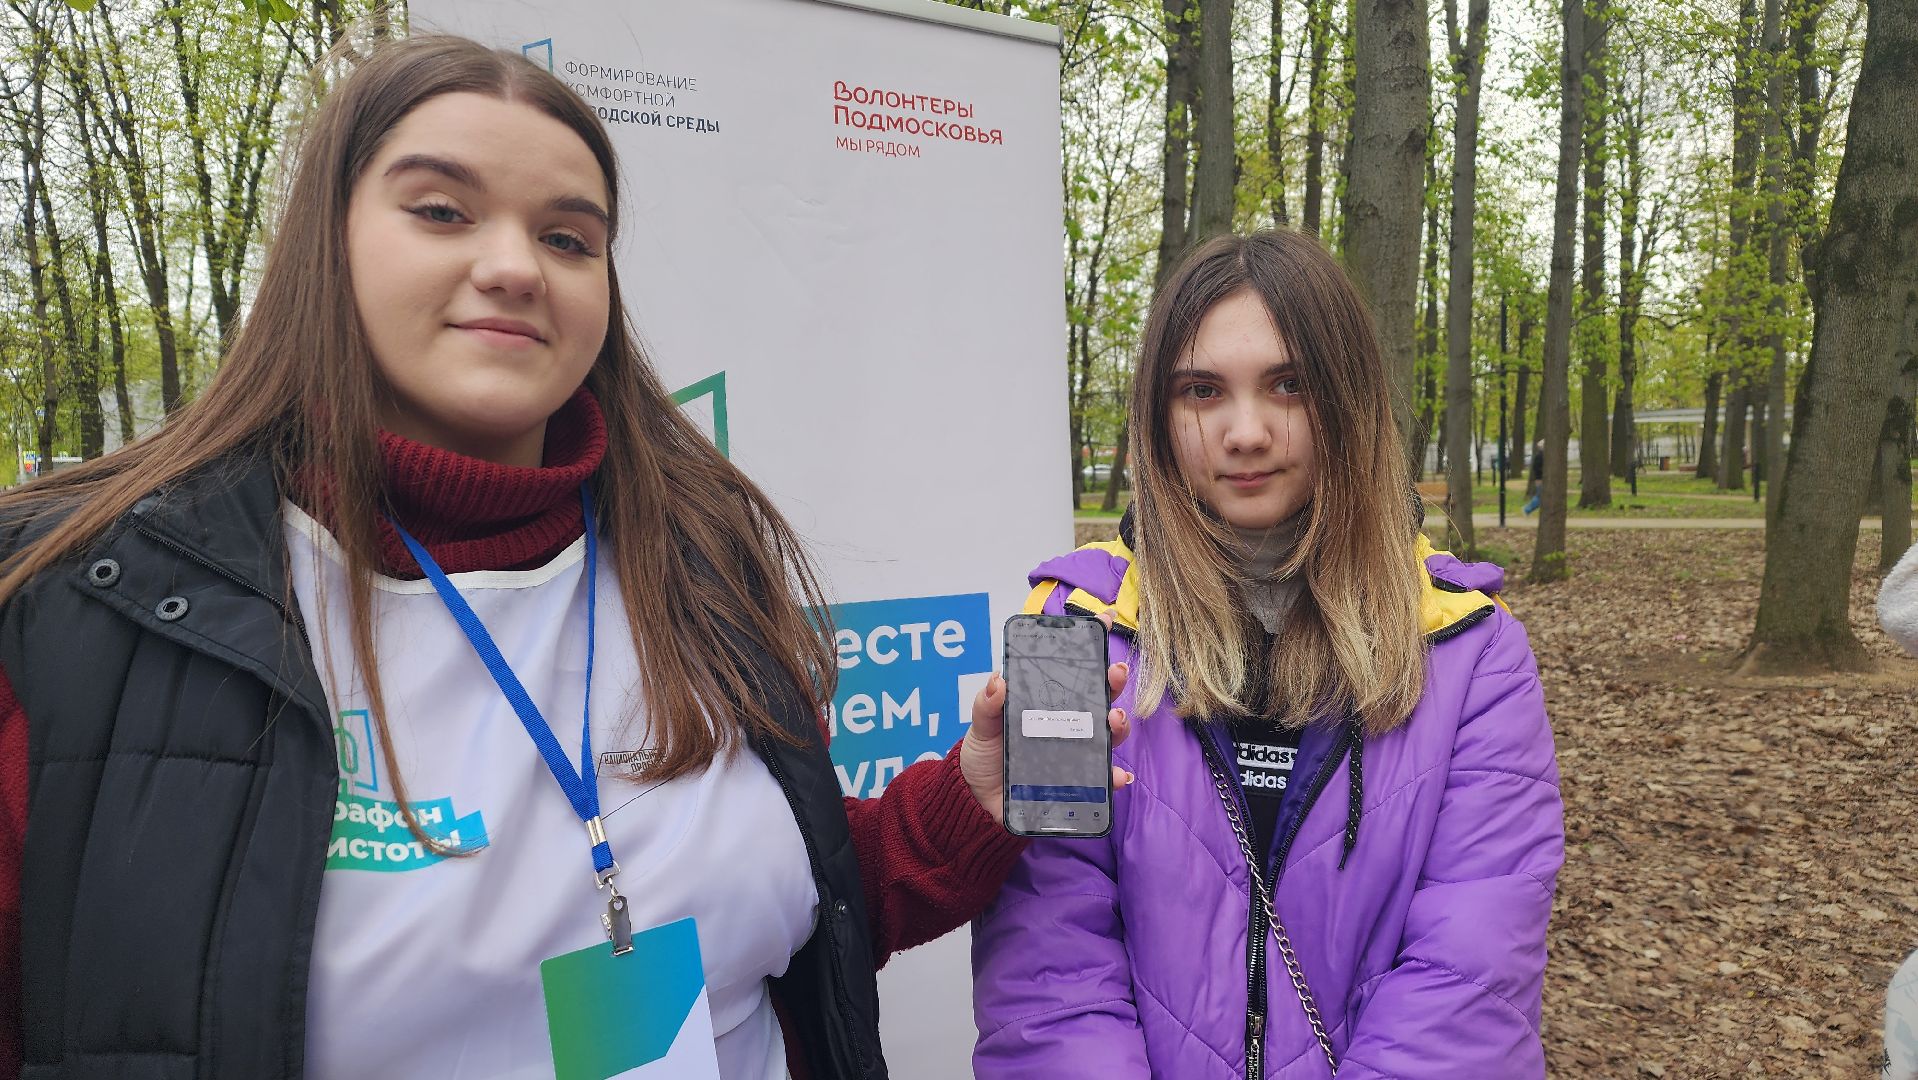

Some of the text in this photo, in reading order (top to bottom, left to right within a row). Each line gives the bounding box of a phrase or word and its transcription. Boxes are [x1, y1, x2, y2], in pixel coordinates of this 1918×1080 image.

[565, 61, 699, 92] ФОРМИРОВАНИЕ
[666, 114, 720, 133] СРЕДЫ
[836, 136, 921, 158] МЫ РЯДОМ
[833, 619, 966, 670] есте
